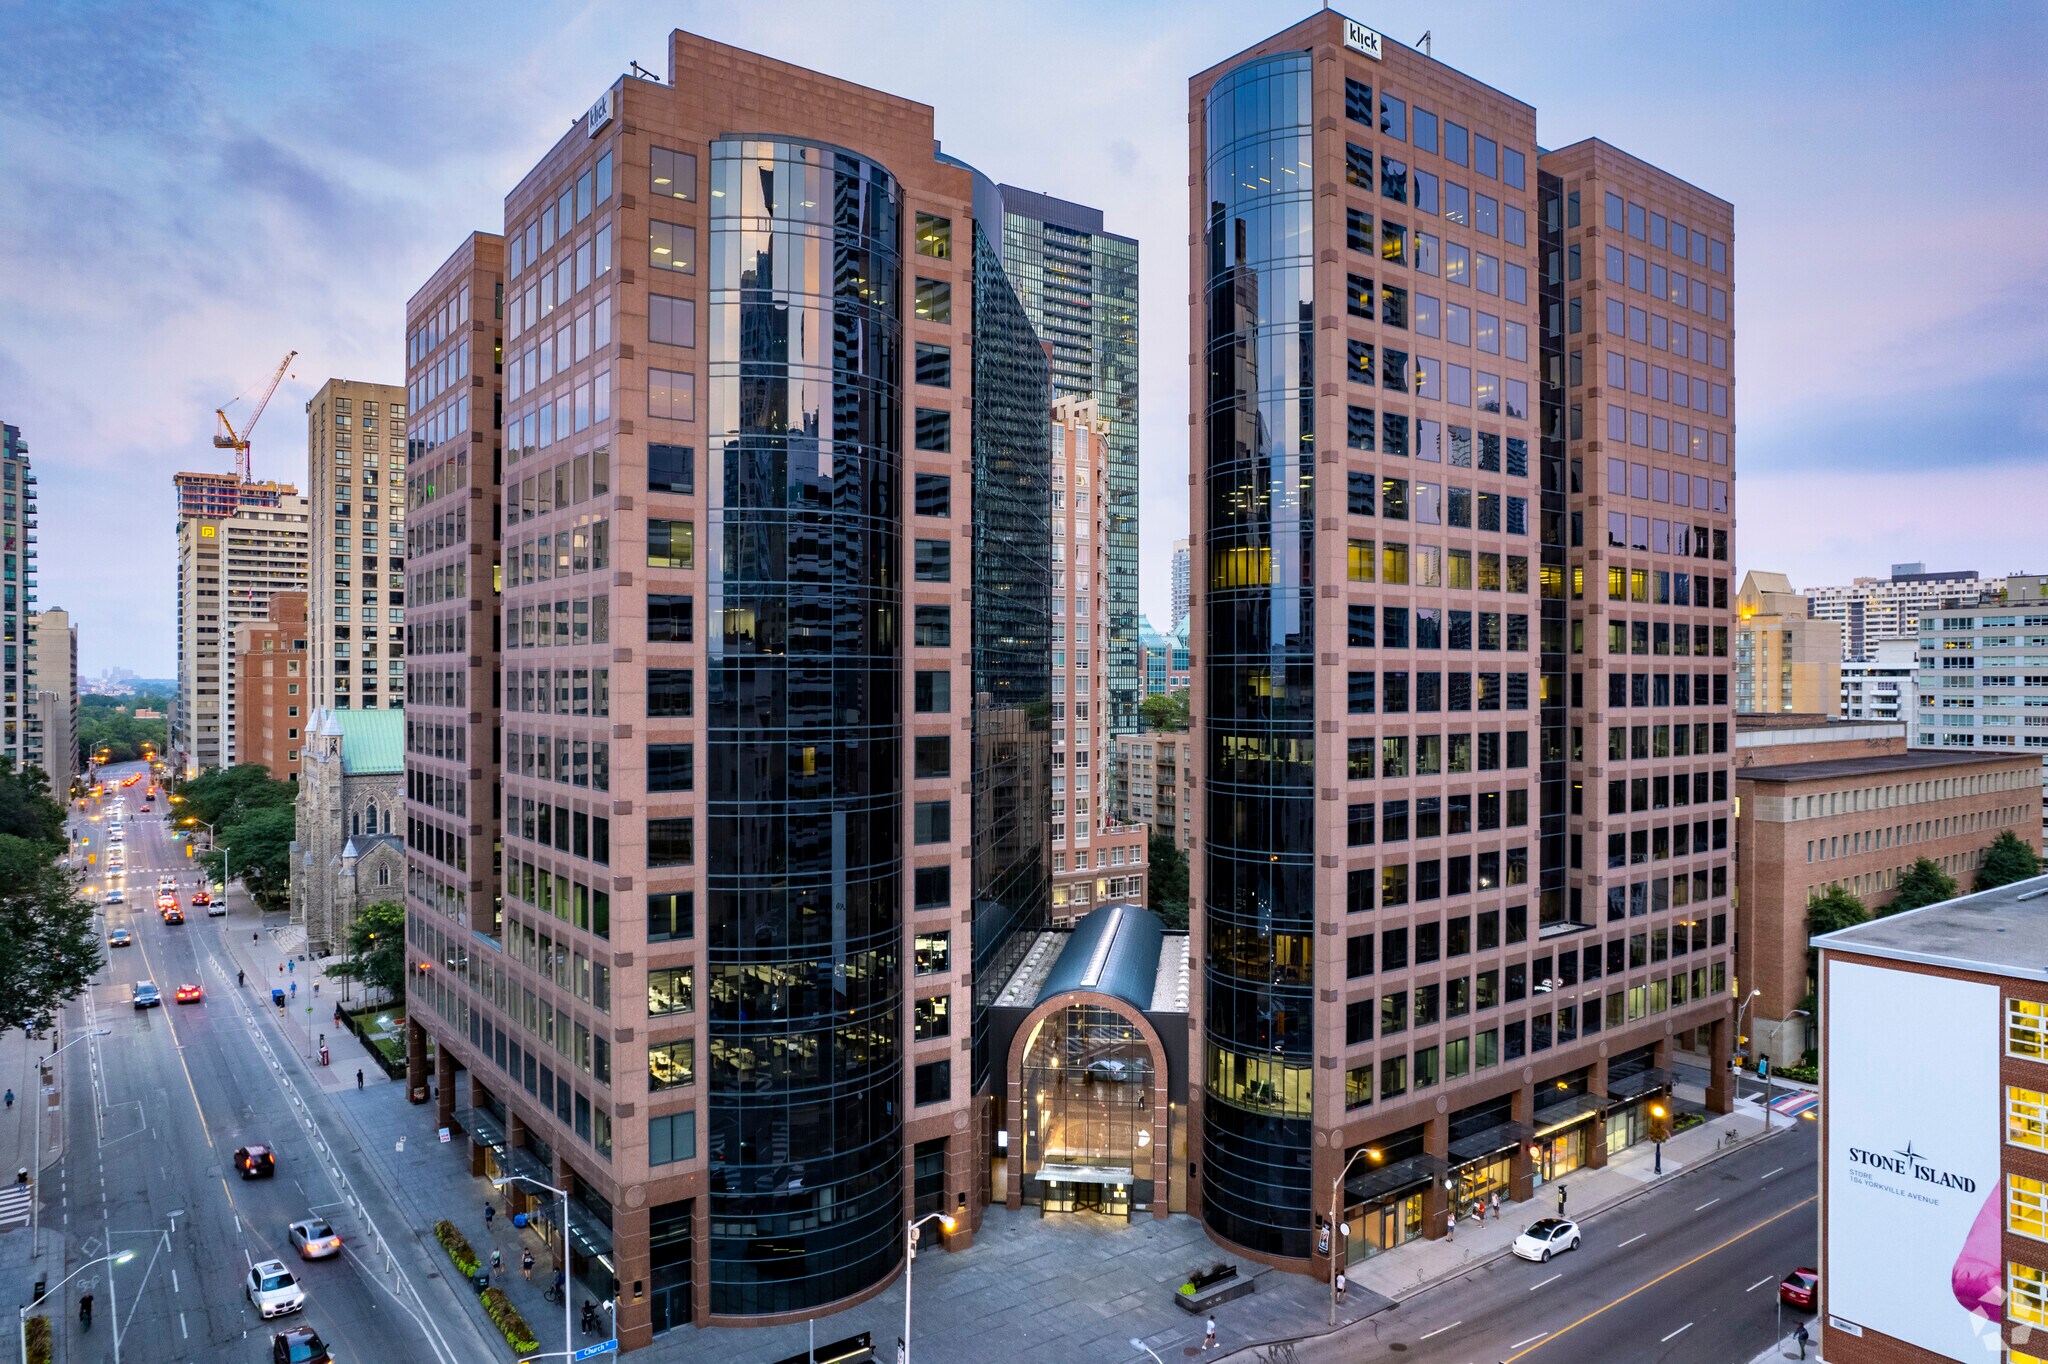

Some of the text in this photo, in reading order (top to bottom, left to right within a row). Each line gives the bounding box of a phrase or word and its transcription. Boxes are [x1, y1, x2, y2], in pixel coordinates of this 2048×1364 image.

[1350, 23, 1378, 51] klick
[590, 97, 607, 128] klick
[1849, 1147, 1976, 1194] STONE ISLAND
[1849, 1169, 1873, 1180] STORE
[1850, 1176, 1940, 1206] 104 YORKVILLE AVENUE
[584, 1345, 605, 1356] Church
